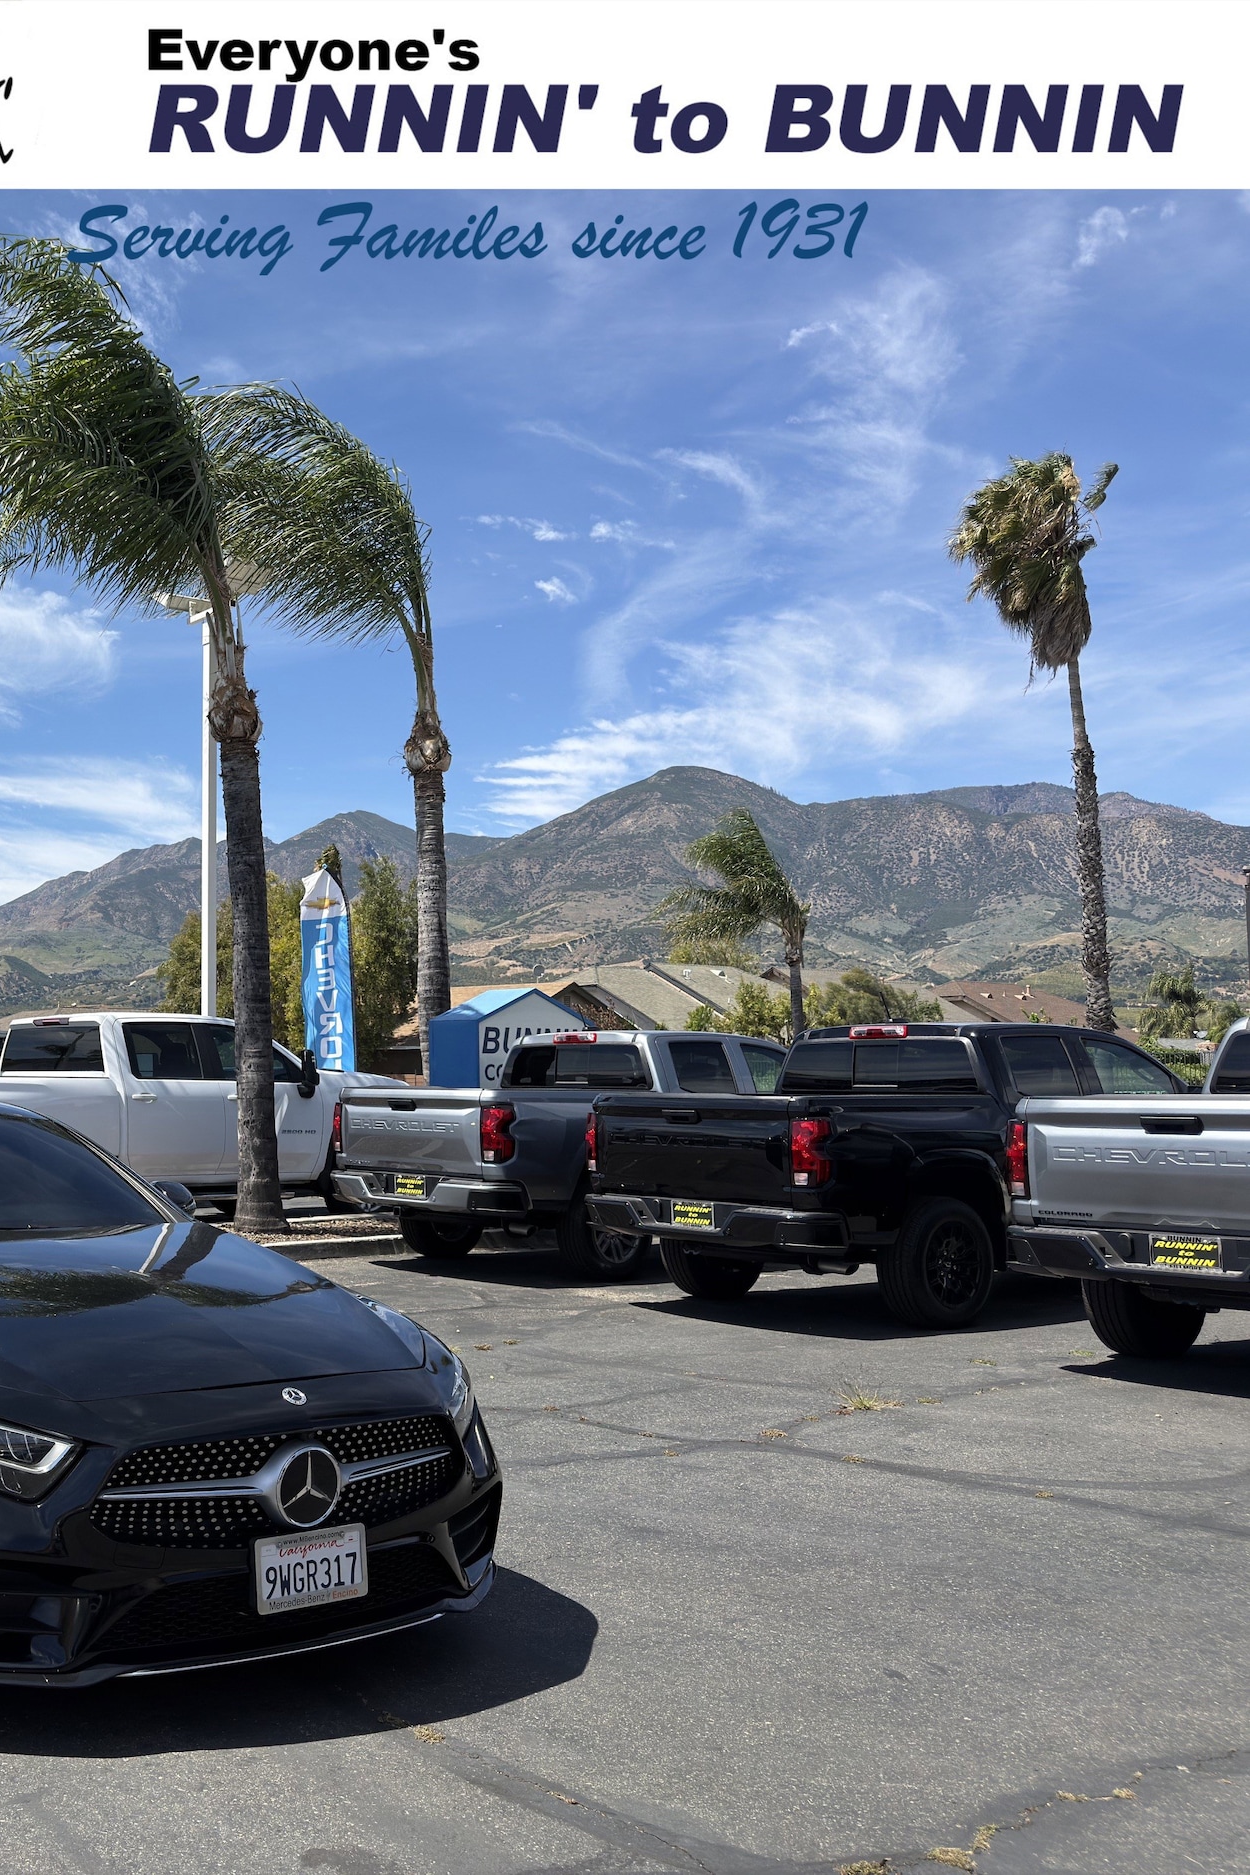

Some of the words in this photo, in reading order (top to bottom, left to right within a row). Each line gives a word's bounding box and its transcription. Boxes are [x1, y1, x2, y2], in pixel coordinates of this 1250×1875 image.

[350, 1119, 460, 1133] CHEVROLET
[1053, 1146, 1250, 1168] CHEVROL
[1038, 1209, 1094, 1218] COLORADO
[674, 1216, 711, 1226] BUNNIN
[1154, 1240, 1218, 1252] RUNNIN'
[1154, 1255, 1216, 1268] BUNNIN
[265, 1551, 358, 1600] 9WGR317
[269, 1593, 326, 1611] Mercedes-Benz
[332, 1588, 359, 1600] Encino
